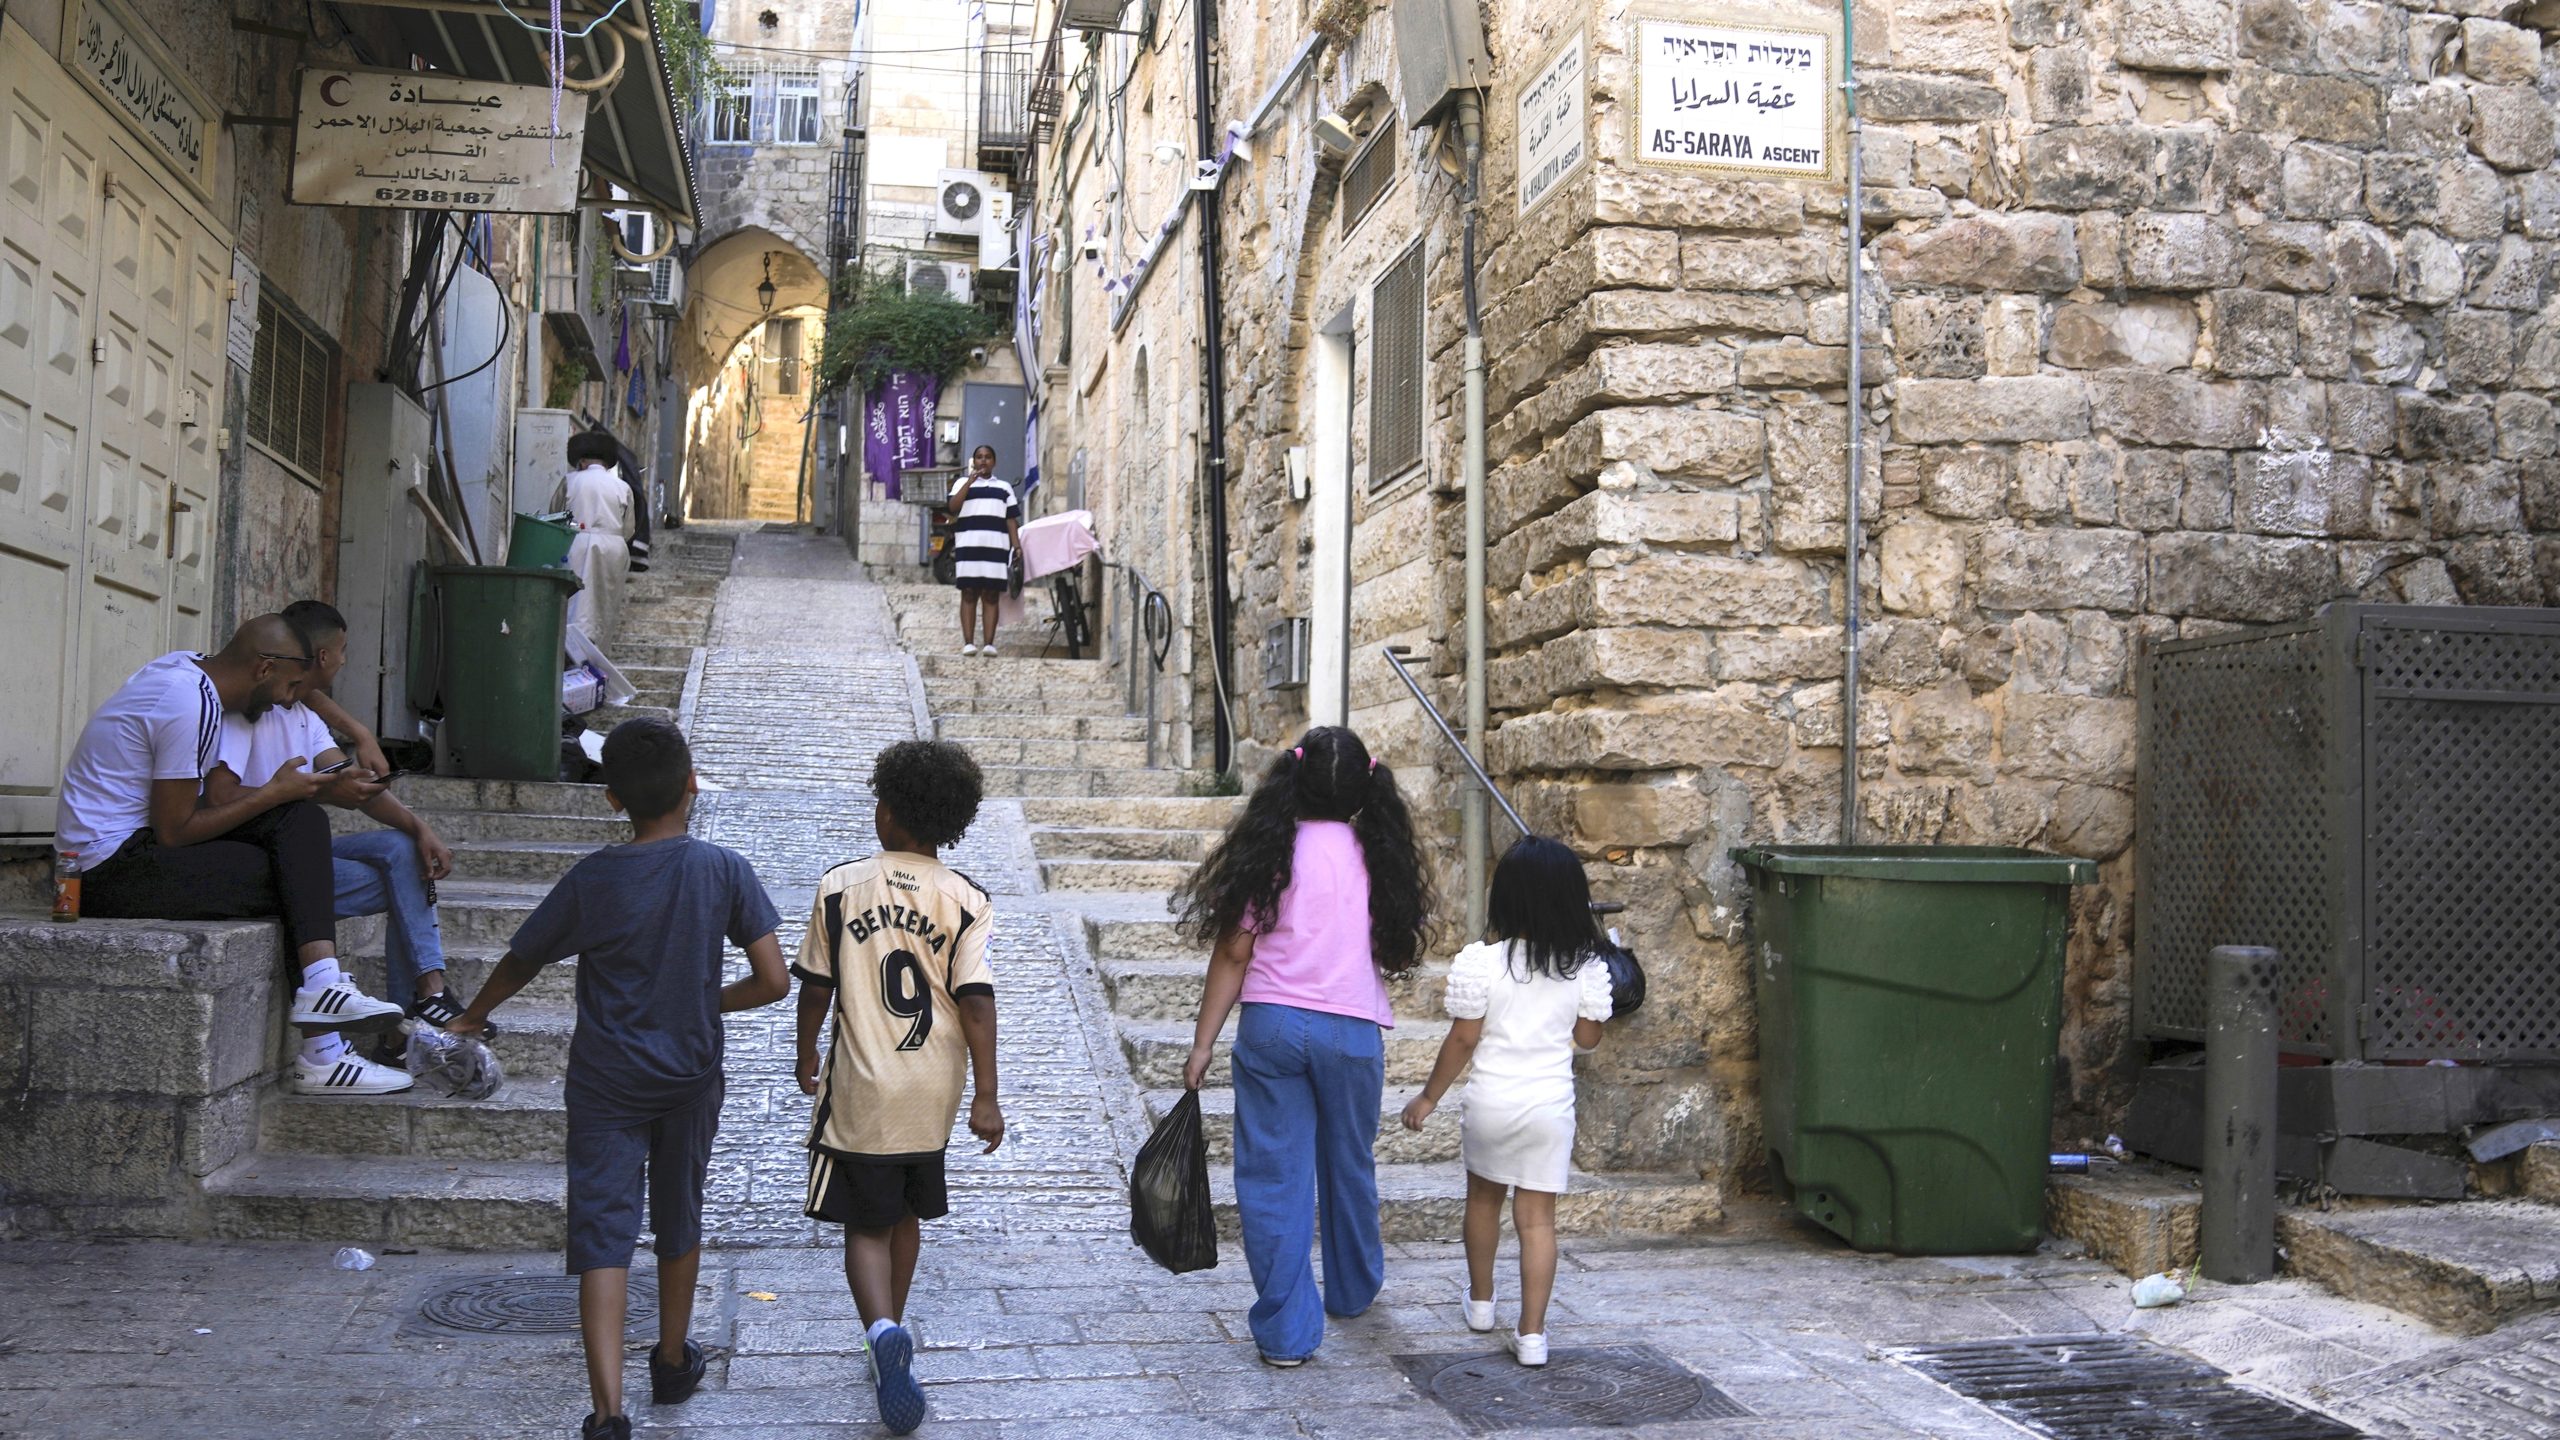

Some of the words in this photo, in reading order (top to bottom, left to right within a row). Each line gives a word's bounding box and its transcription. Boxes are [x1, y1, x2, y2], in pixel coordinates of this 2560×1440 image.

[389, 75, 502, 112] عيادة
[1671, 76, 1739, 112] السرايا
[1747, 82, 1796, 114] عقبة
[379, 116, 431, 135] الهلال
[434, 118, 493, 139] جمعية
[395, 143, 487, 158] القدس
[1561, 141, 1582, 174] ASCENT
[1652, 129, 1753, 159] AS-SARAYA
[1763, 146, 1820, 164] ASCENT
[355, 164, 455, 183] الخالدية
[459, 169, 520, 189] عقبة
[375, 187, 495, 205] 6288187
[898, 394, 910, 418] הוא
[847, 904, 947, 955] BENZEMA
[880, 948, 933, 1051] 9
